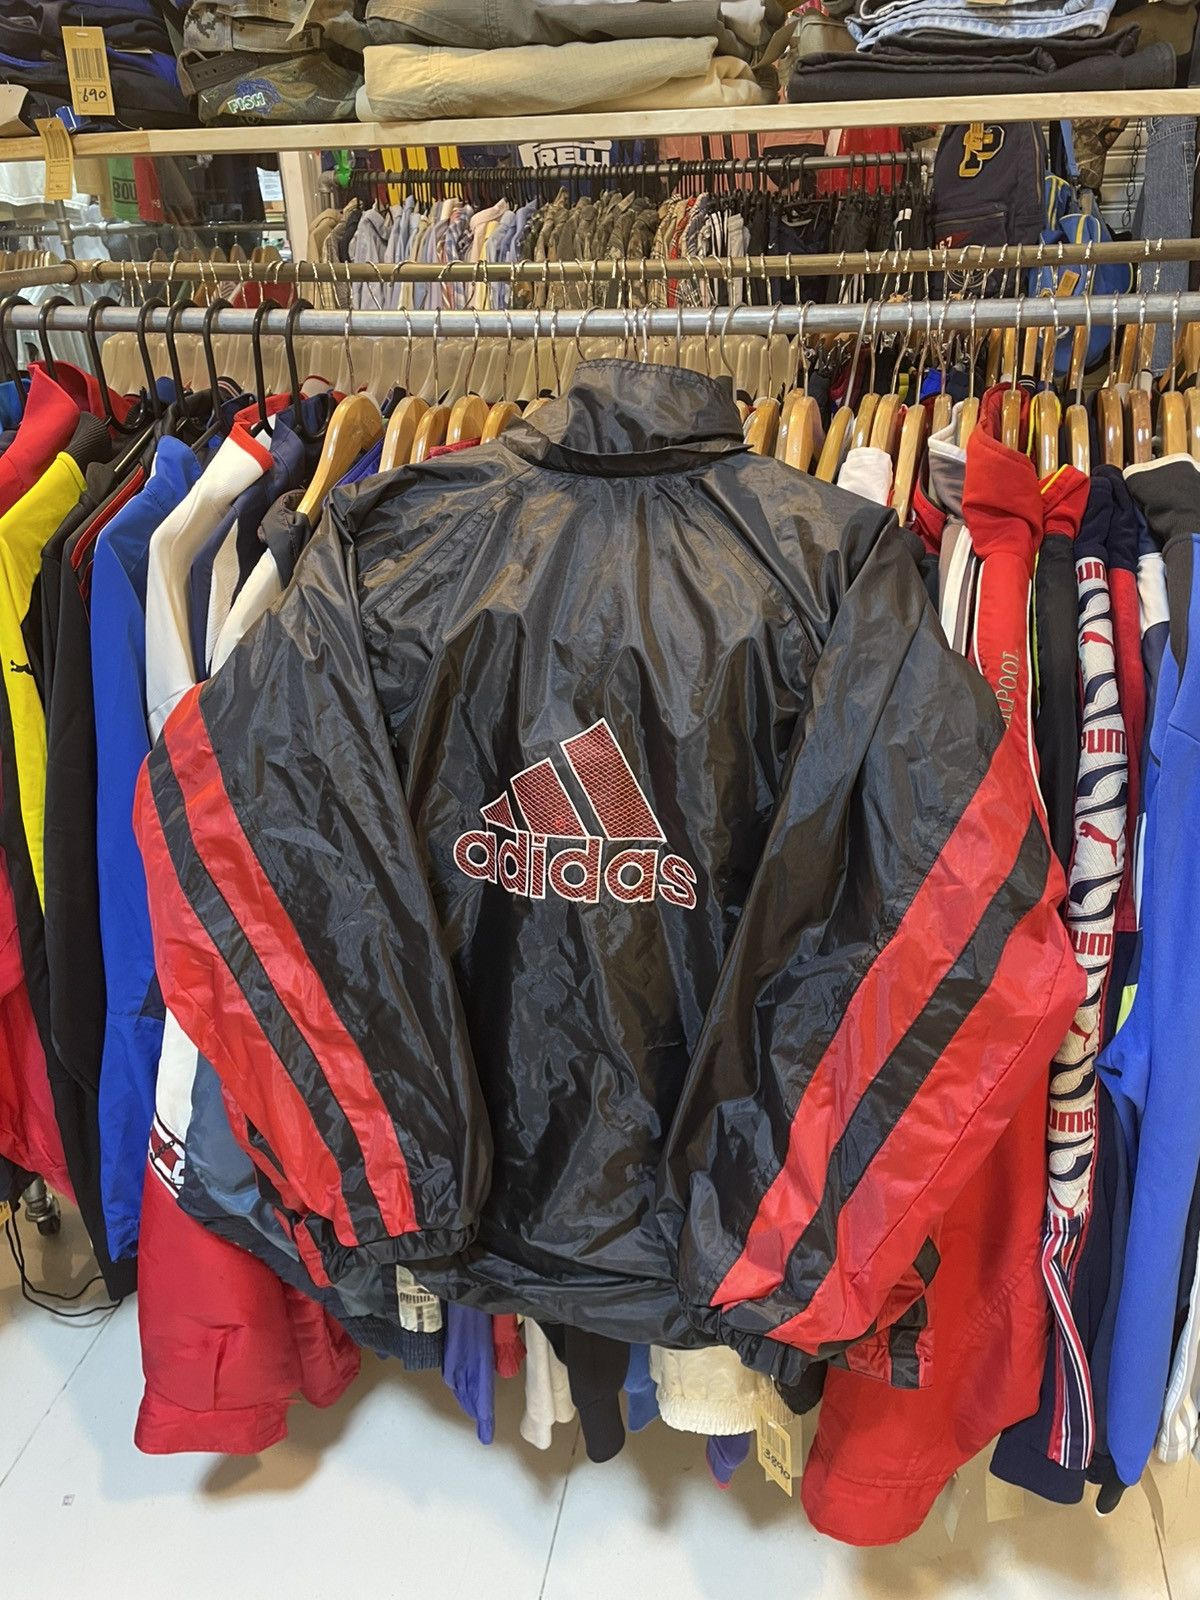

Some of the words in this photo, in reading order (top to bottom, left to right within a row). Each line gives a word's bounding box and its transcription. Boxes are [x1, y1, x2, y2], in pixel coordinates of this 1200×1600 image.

[82, 87, 107, 102] 690
[227, 91, 266, 114] FISH
[453, 830, 697, 909] adidas
